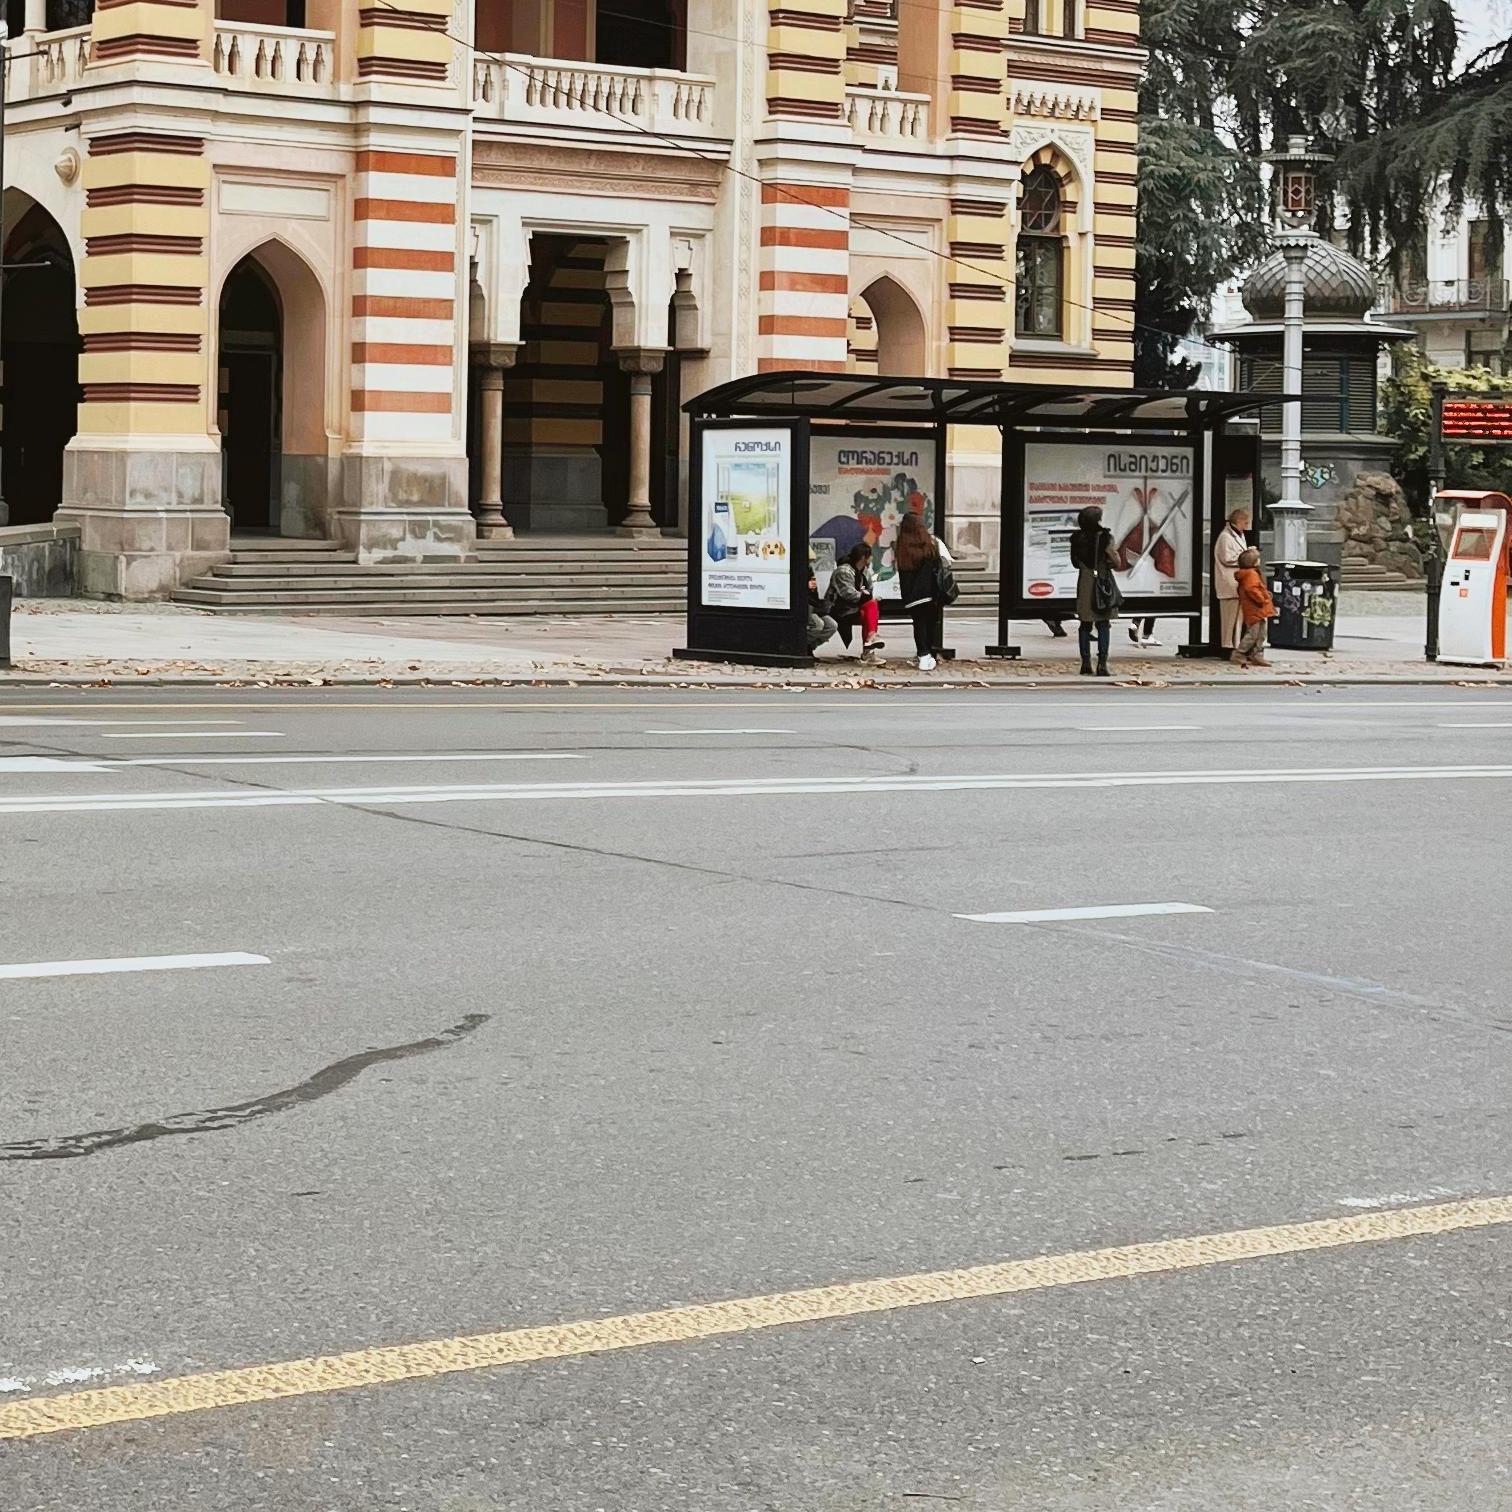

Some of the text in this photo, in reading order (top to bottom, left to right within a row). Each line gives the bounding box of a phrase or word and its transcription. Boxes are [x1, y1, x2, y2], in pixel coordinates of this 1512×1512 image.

[734, 441, 781, 452] რენოქსი
[838, 449, 919, 466] ლორანექსი
[1107, 453, 1190, 474] ისმიჟენი
